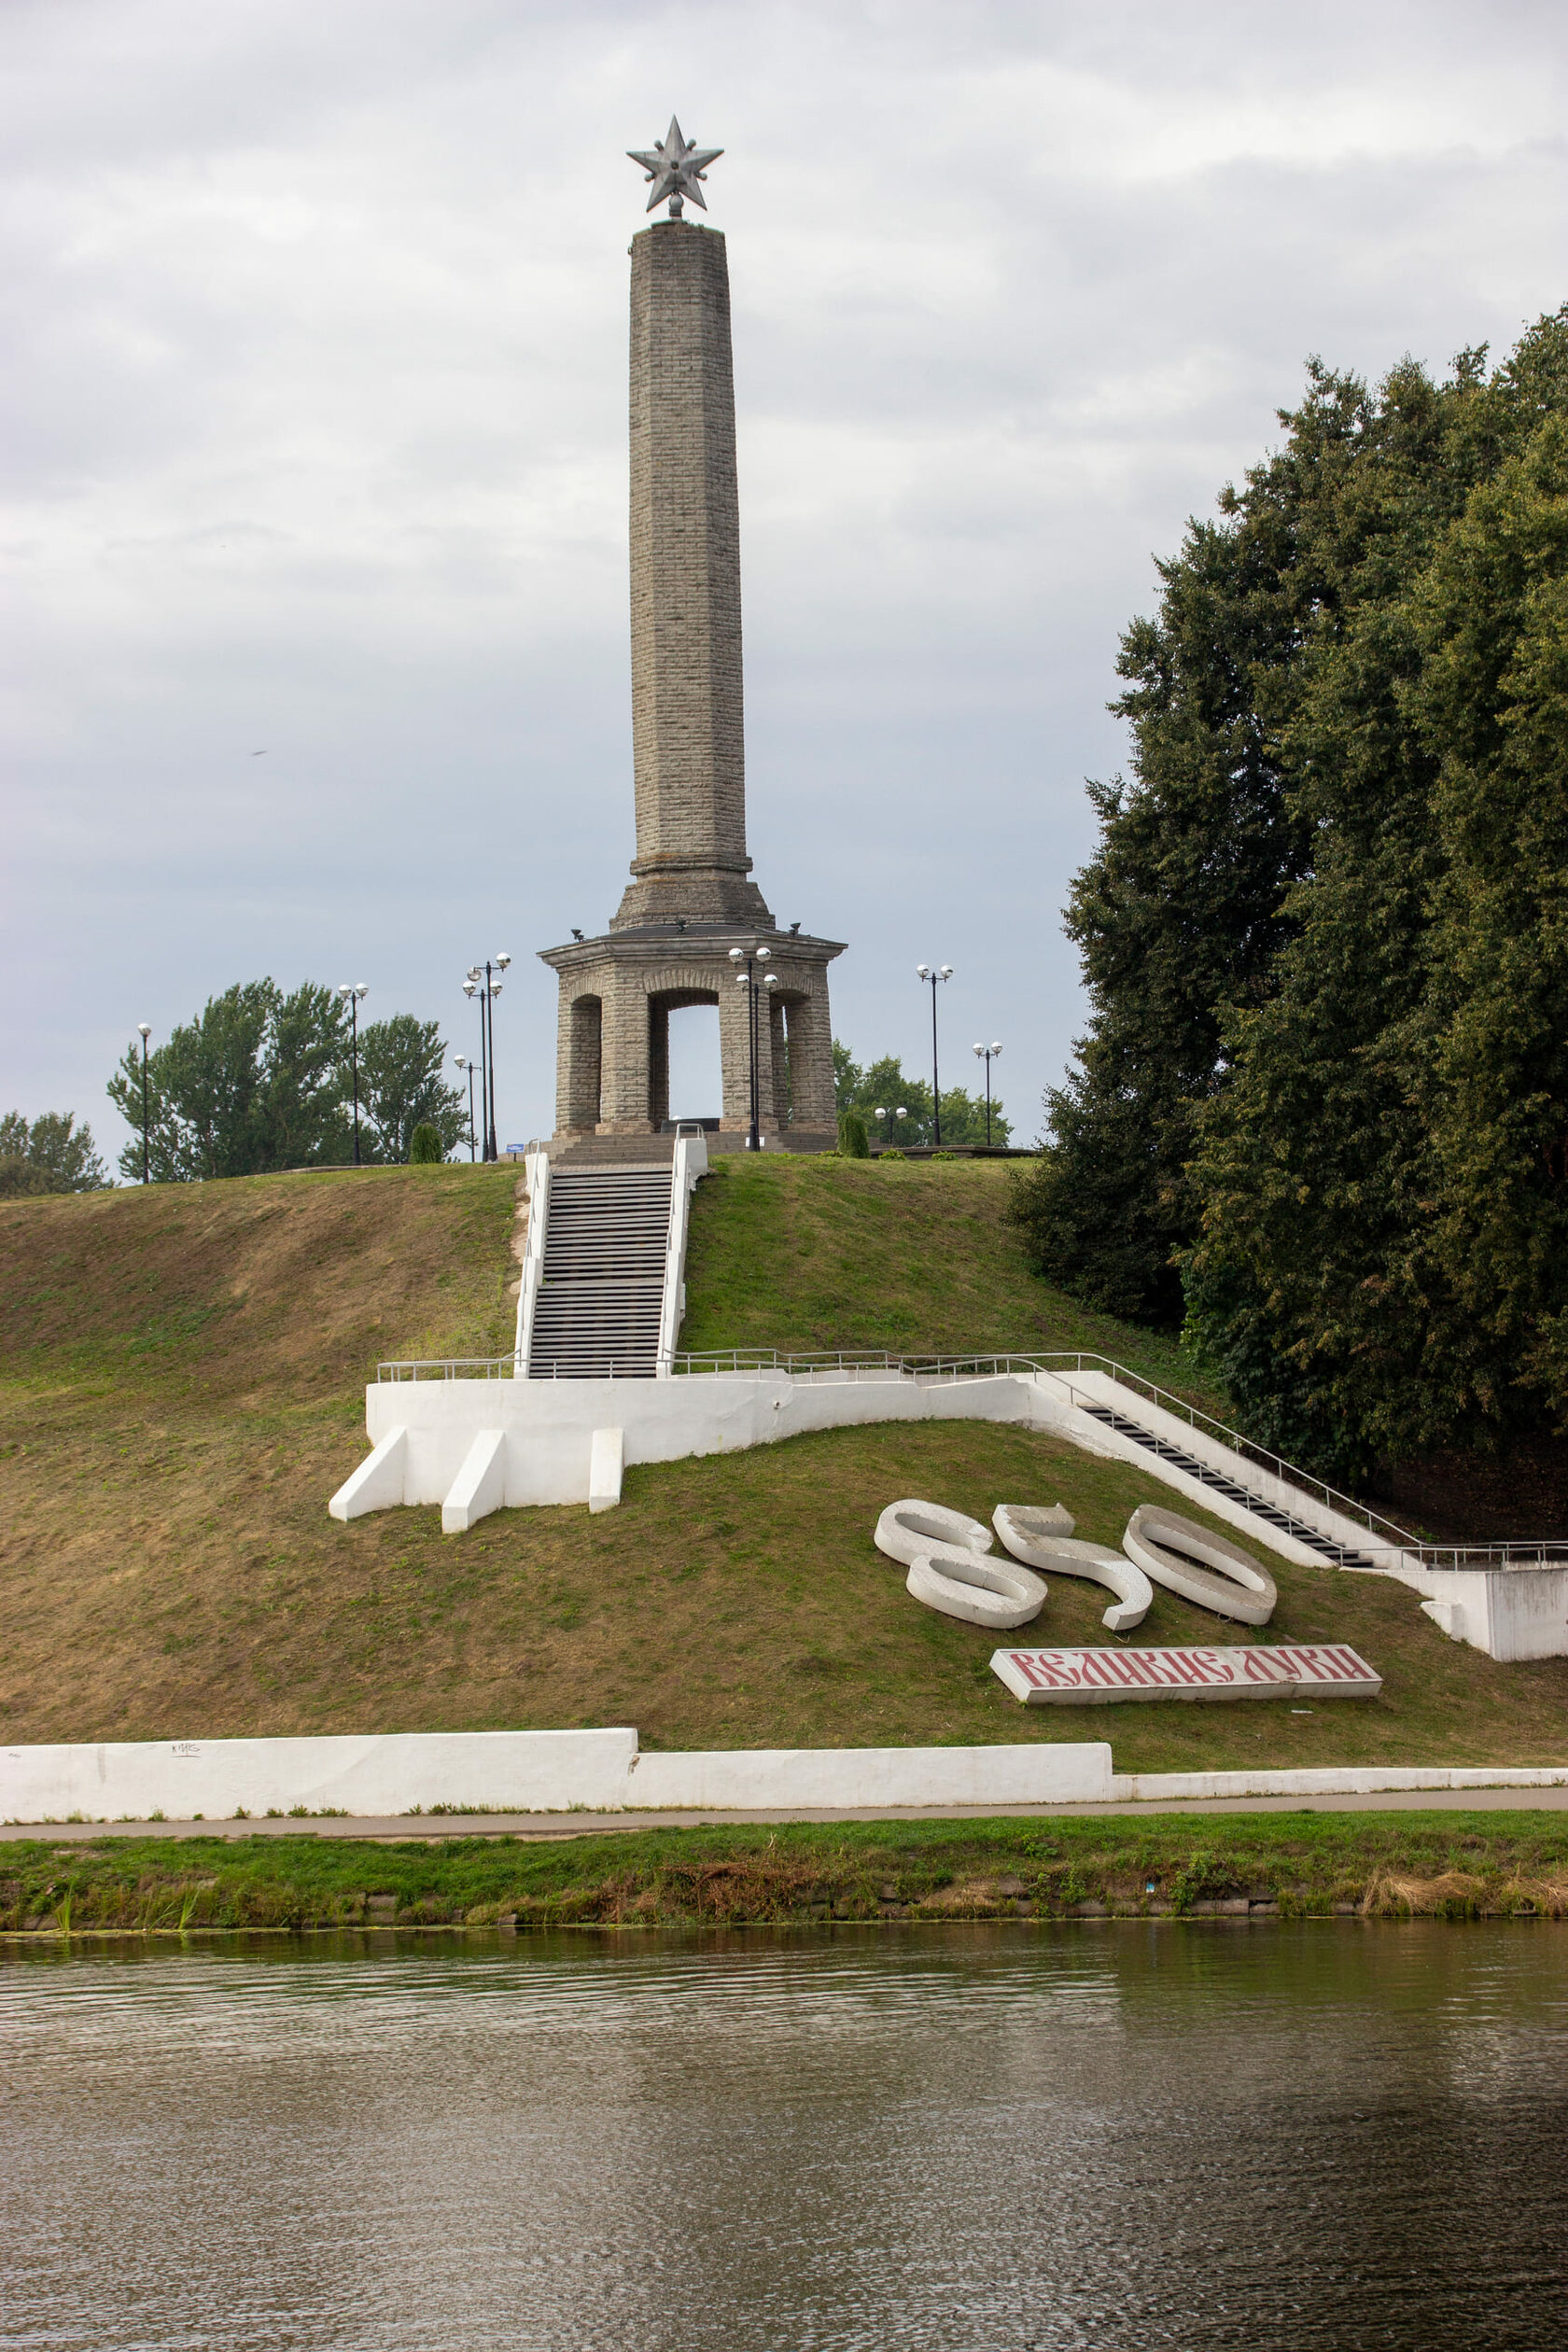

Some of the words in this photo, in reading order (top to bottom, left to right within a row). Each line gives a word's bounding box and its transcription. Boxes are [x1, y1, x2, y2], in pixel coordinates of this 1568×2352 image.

[874, 1499, 1277, 1631] 850
[1010, 1650, 1234, 1687] ВЕЛИКИЕ
[1233, 1648, 1377, 1681] ЛУКИ
